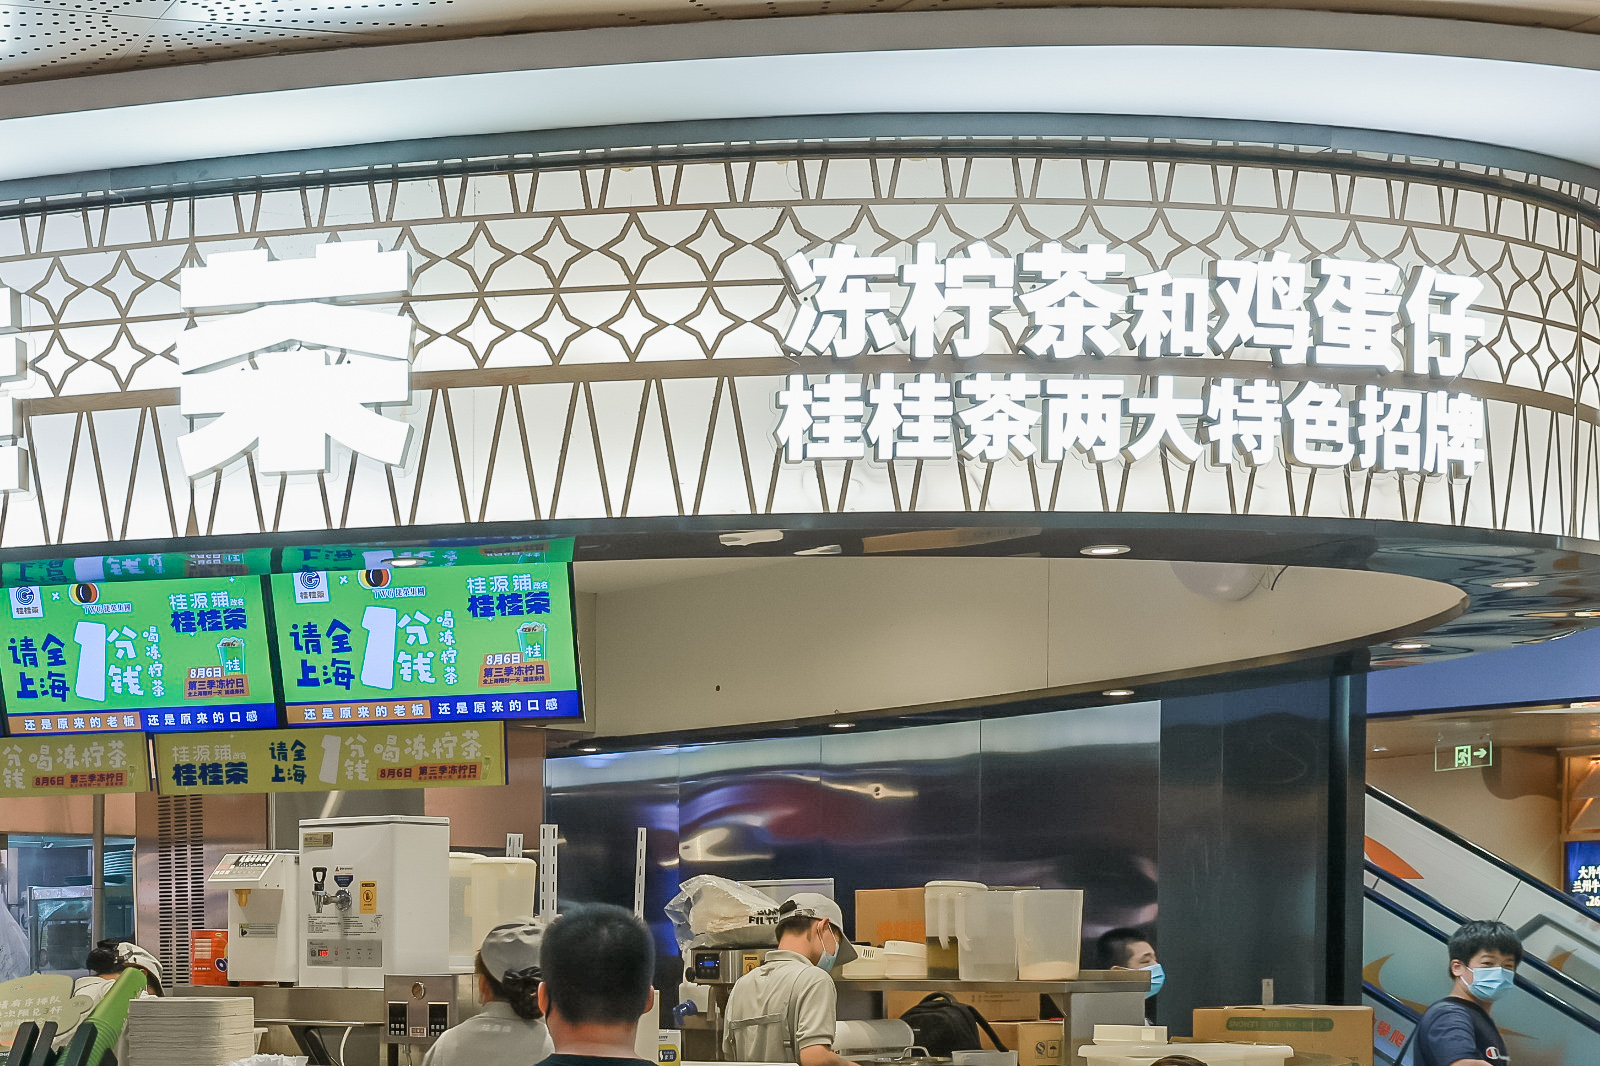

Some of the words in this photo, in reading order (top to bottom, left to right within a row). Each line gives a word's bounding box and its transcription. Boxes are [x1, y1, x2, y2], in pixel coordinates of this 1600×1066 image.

[783, 242, 1486, 376] 冻柠茶和鸡蛋仔
[777, 373, 1485, 480] 桂桂茶两大特色招牌
[466, 592, 551, 618] 桂桂茶
[171, 608, 247, 633] 桂桂茶
[290, 619, 352, 655] 请全
[361, 606, 397, 690] 1
[436, 611, 457, 685] 喝冻柠茶
[8, 632, 67, 667] 请全
[73, 621, 106, 701] 1
[143, 625, 164, 697] 喝冻柠茶
[486, 653, 520, 665] 8月6日
[525, 643, 541, 658] 桂
[190, 667, 221, 678] 8月6日
[226, 656, 240, 671] 桂
[296, 658, 355, 690] 上海
[483, 665, 544, 678] 第三季冻柠日
[17, 671, 70, 702] 上海
[188, 679, 245, 691] 第三季冻柠日
[147, 710, 258, 726] 还是原来的口感
[304, 703, 424, 721] 还是原来的老板
[438, 699, 558, 715] 还是原来的口感
[24, 715, 135, 731] 还是原来的老板
[28, 740, 127, 772] 喝冻柠茶
[269, 739, 307, 762] 请全
[374, 730, 482, 763] 喝冻柠茶
[319, 734, 341, 784] 1
[418, 764, 478, 777] 第三季冻柠日
[35, 776, 64, 787] 8月6日
[69, 773, 123, 784] 第三季冻柠日
[171, 762, 248, 786] 桂桂茶
[271, 763, 307, 784] 上海
[380, 767, 413, 779] 8月6日
[749, 915, 780, 925] FILTE
